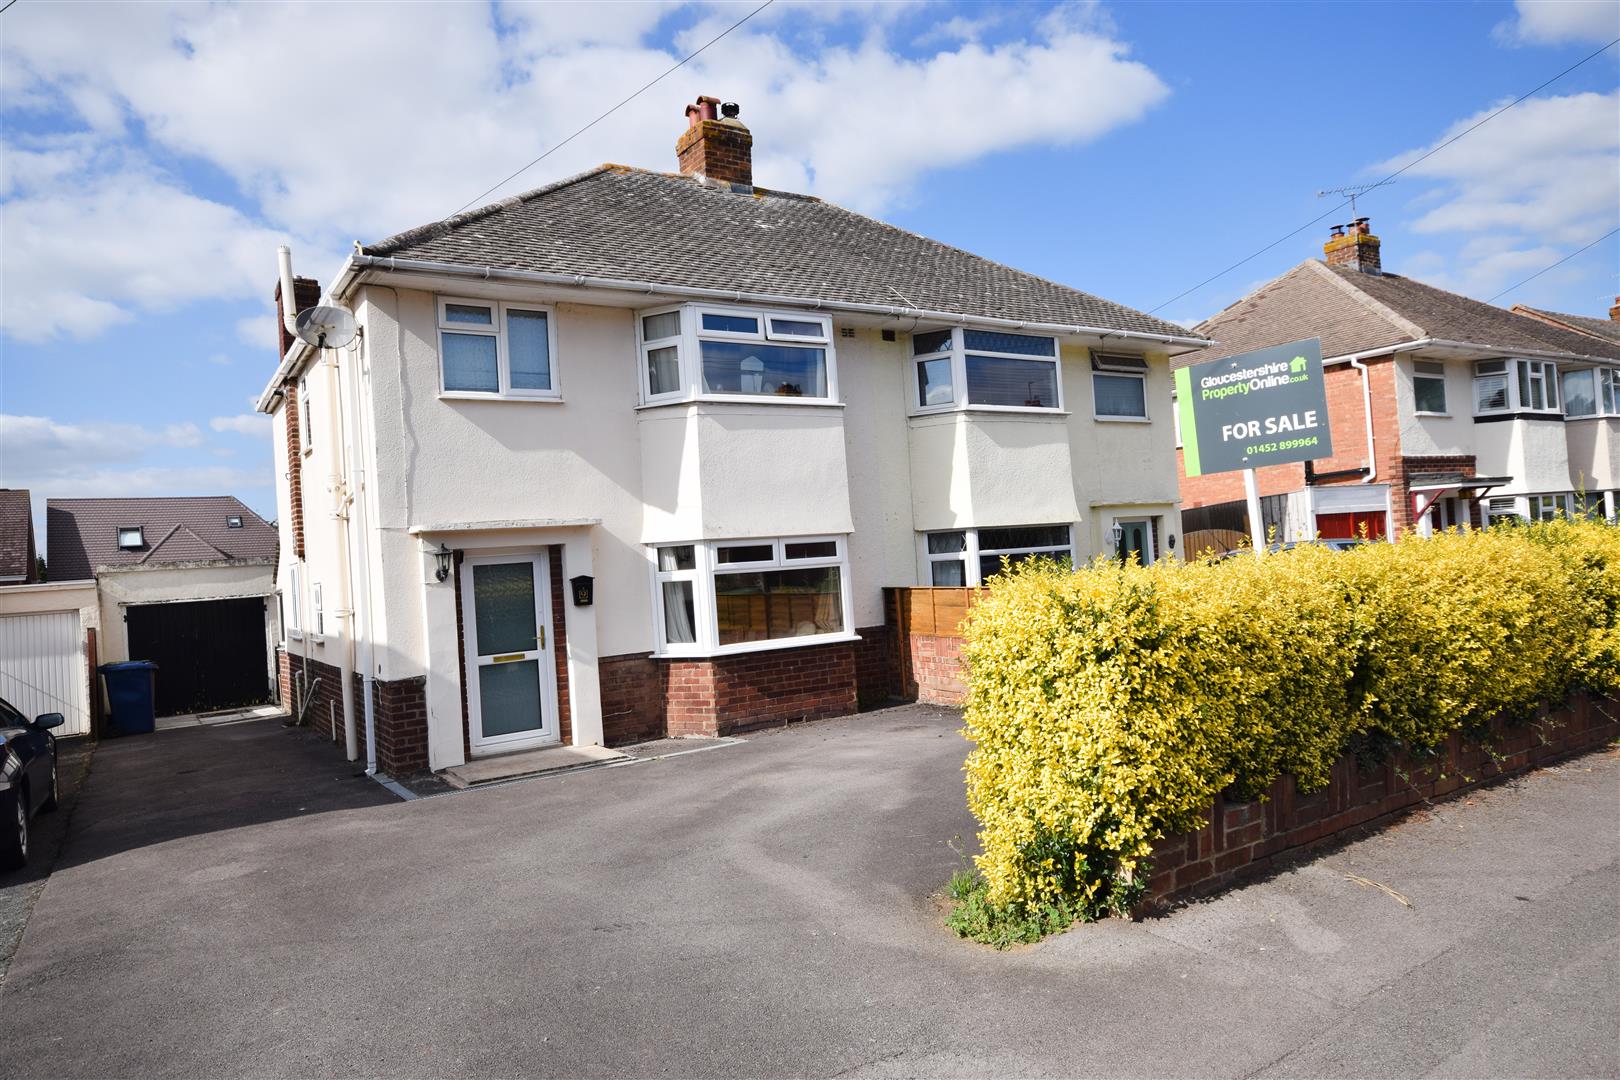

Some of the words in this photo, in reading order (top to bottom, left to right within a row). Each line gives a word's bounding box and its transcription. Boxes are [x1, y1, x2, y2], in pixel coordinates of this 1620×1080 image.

[1201, 362, 1288, 388] Gloucestershire
[1222, 420, 1261, 441] FOR
[1265, 410, 1318, 434] SALE
[1247, 443, 1277, 454] 01452
[1279, 436, 1318, 449] 899964
